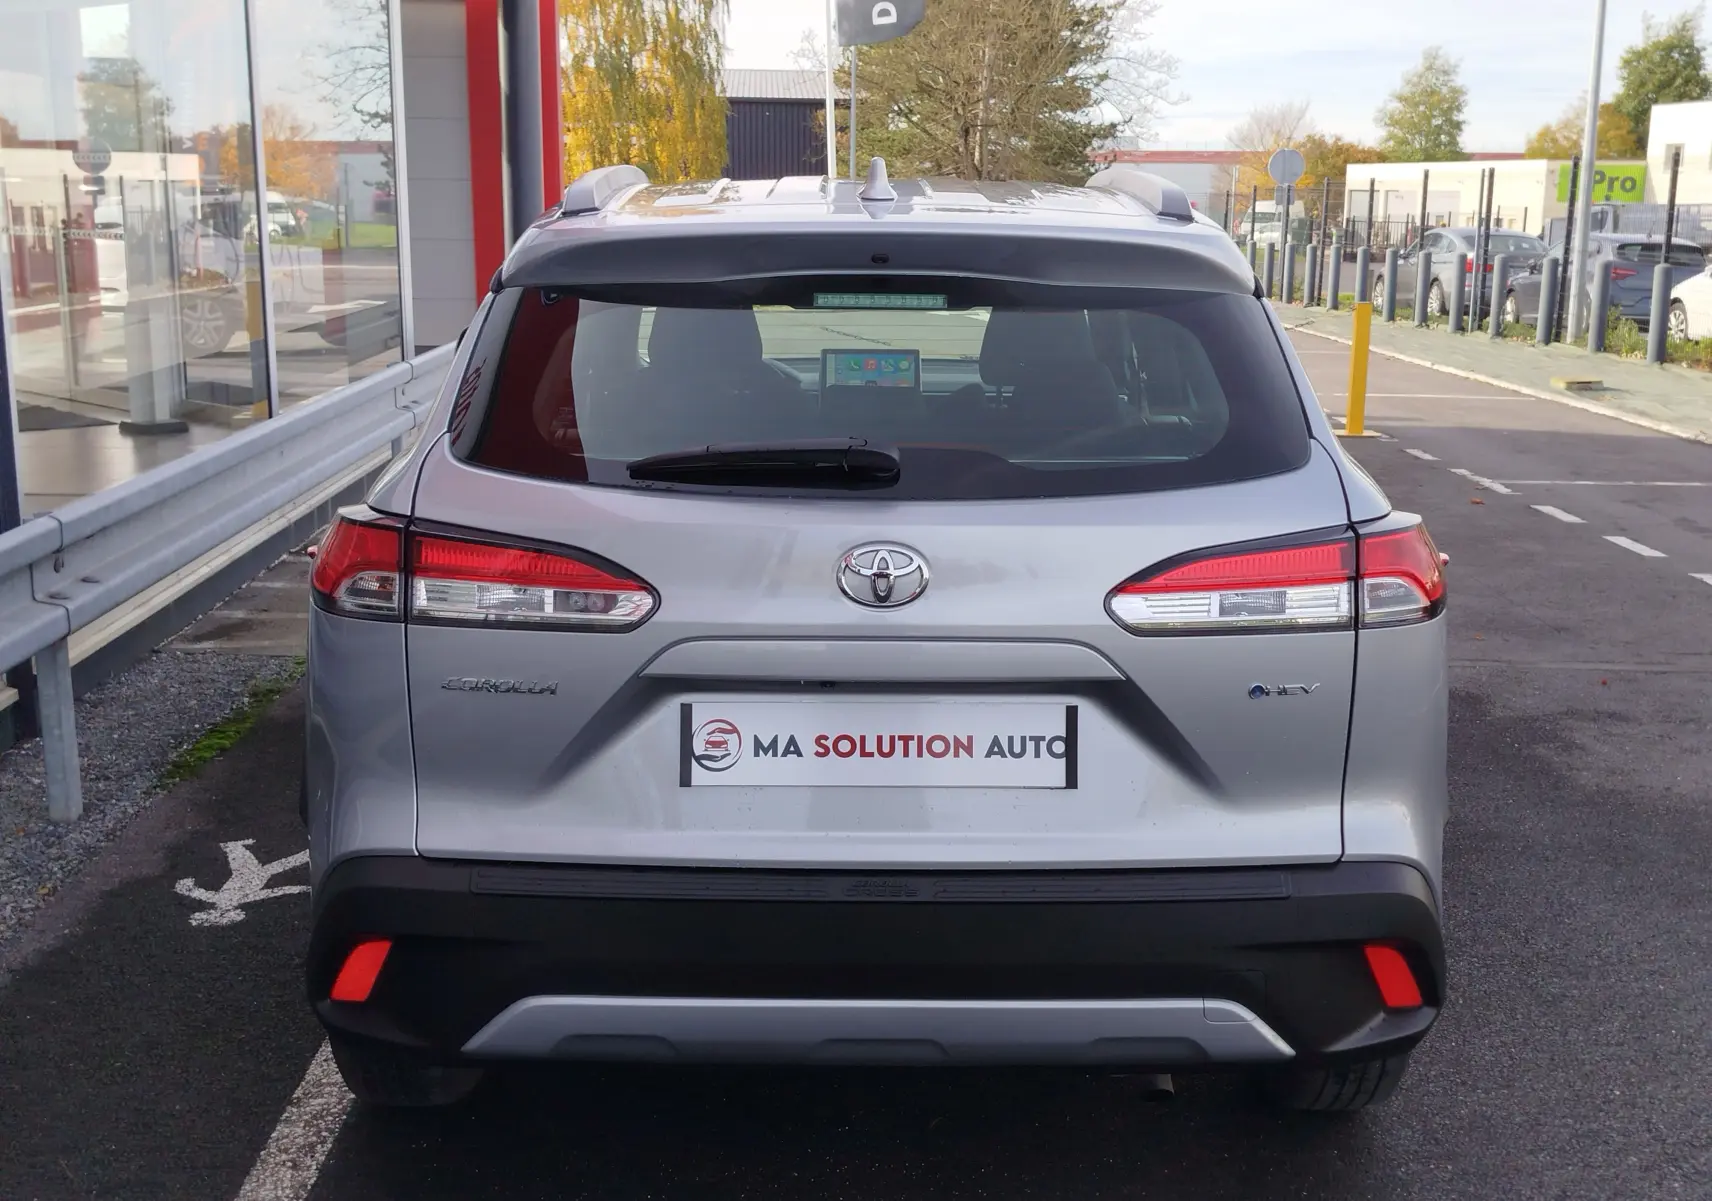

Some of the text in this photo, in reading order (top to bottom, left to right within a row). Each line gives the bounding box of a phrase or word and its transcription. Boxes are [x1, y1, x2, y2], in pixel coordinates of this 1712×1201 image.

[1592, 170, 1637, 193] Pro
[441, 677, 558, 695] COROLLA
[753, 734, 1067, 759] MA SOLUTION AUTO
